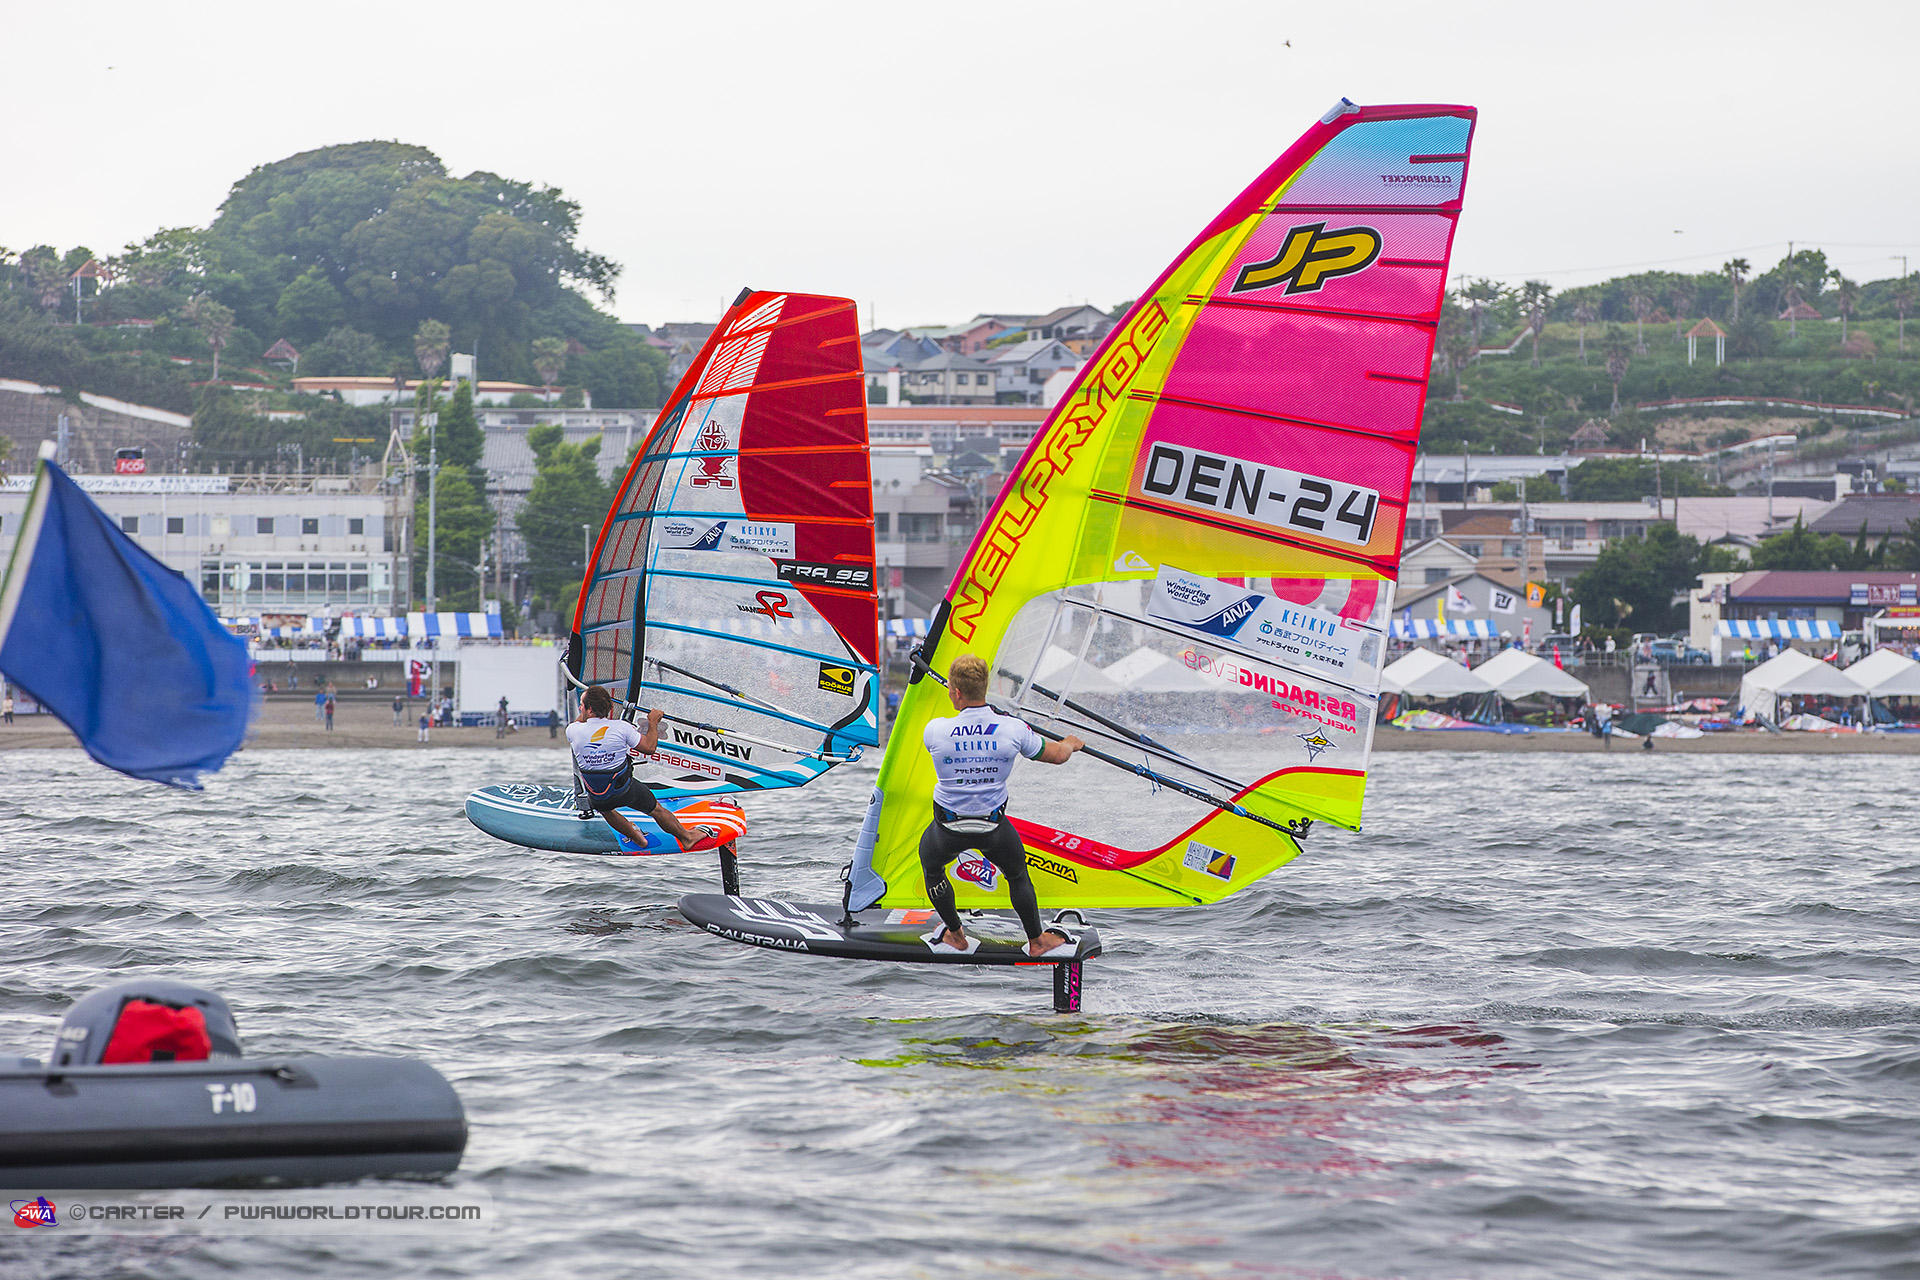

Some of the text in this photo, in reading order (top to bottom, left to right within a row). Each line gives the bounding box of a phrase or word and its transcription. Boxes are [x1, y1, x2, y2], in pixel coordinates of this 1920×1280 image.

[1229, 220, 1382, 296] JP
[949, 299, 1169, 644] NEILPRYDE
[1143, 445, 1378, 542] DEN-24
[705, 526, 723, 545] ANA
[741, 525, 777, 537] KEIKYU
[780, 564, 869, 582] FRA 99
[1166, 580, 1211, 601] Windsurfing
[1167, 587, 1207, 606] World Cup
[1222, 600, 1254, 627] ANA
[1281, 609, 1336, 637] KEIKYU
[1273, 627, 1349, 656] 西武プロパティーズ
[950, 724, 983, 738] ANA
[955, 740, 997, 751] KEIKYU
[1050, 831, 1082, 850] 7.8
[961, 862, 991, 881] PWA
[704, 922, 810, 951] JP-AUSTRALIA
